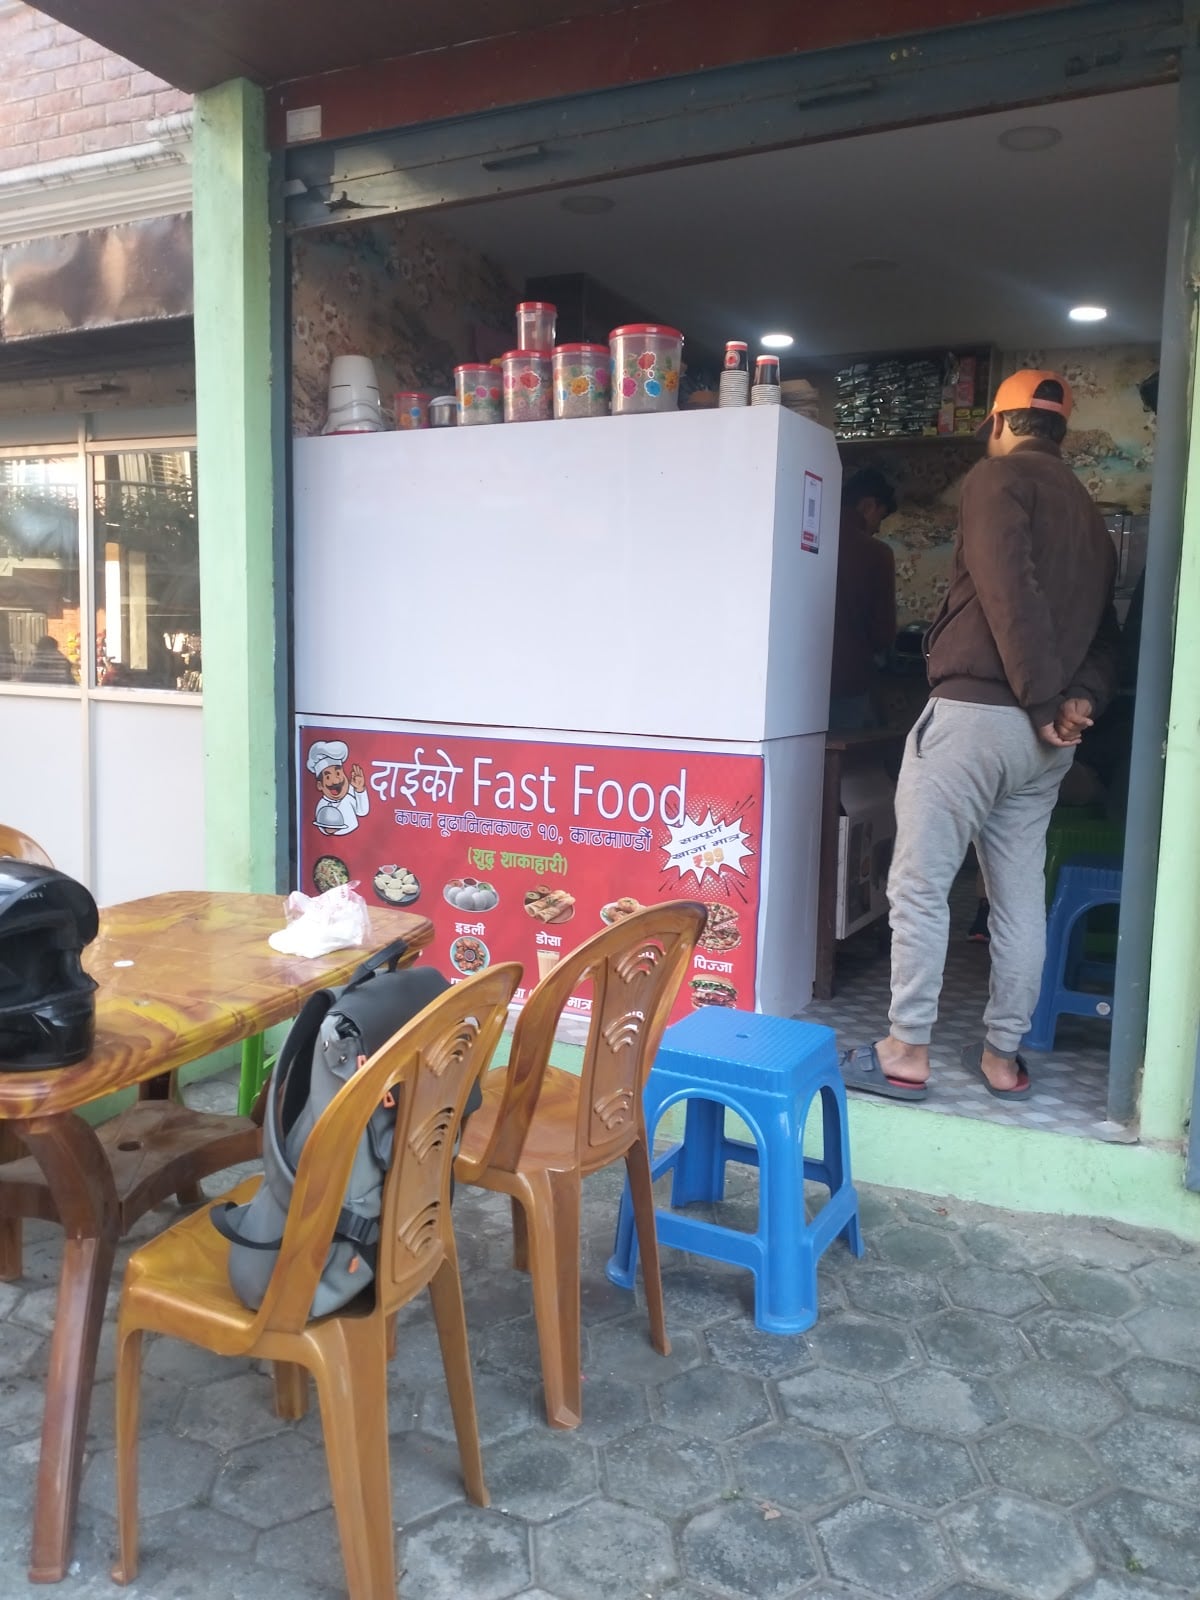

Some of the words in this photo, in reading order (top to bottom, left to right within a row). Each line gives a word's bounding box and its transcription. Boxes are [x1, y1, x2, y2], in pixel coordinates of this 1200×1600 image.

[370, 747, 464, 806] दाईको
[473, 757, 557, 814] Fast
[573, 764, 687, 827] Food
[394, 809, 433, 829] कपन
[455, 922, 486, 936] इडली
[535, 931, 562, 947] डोसा
[693, 954, 734, 974] पिज्जा
